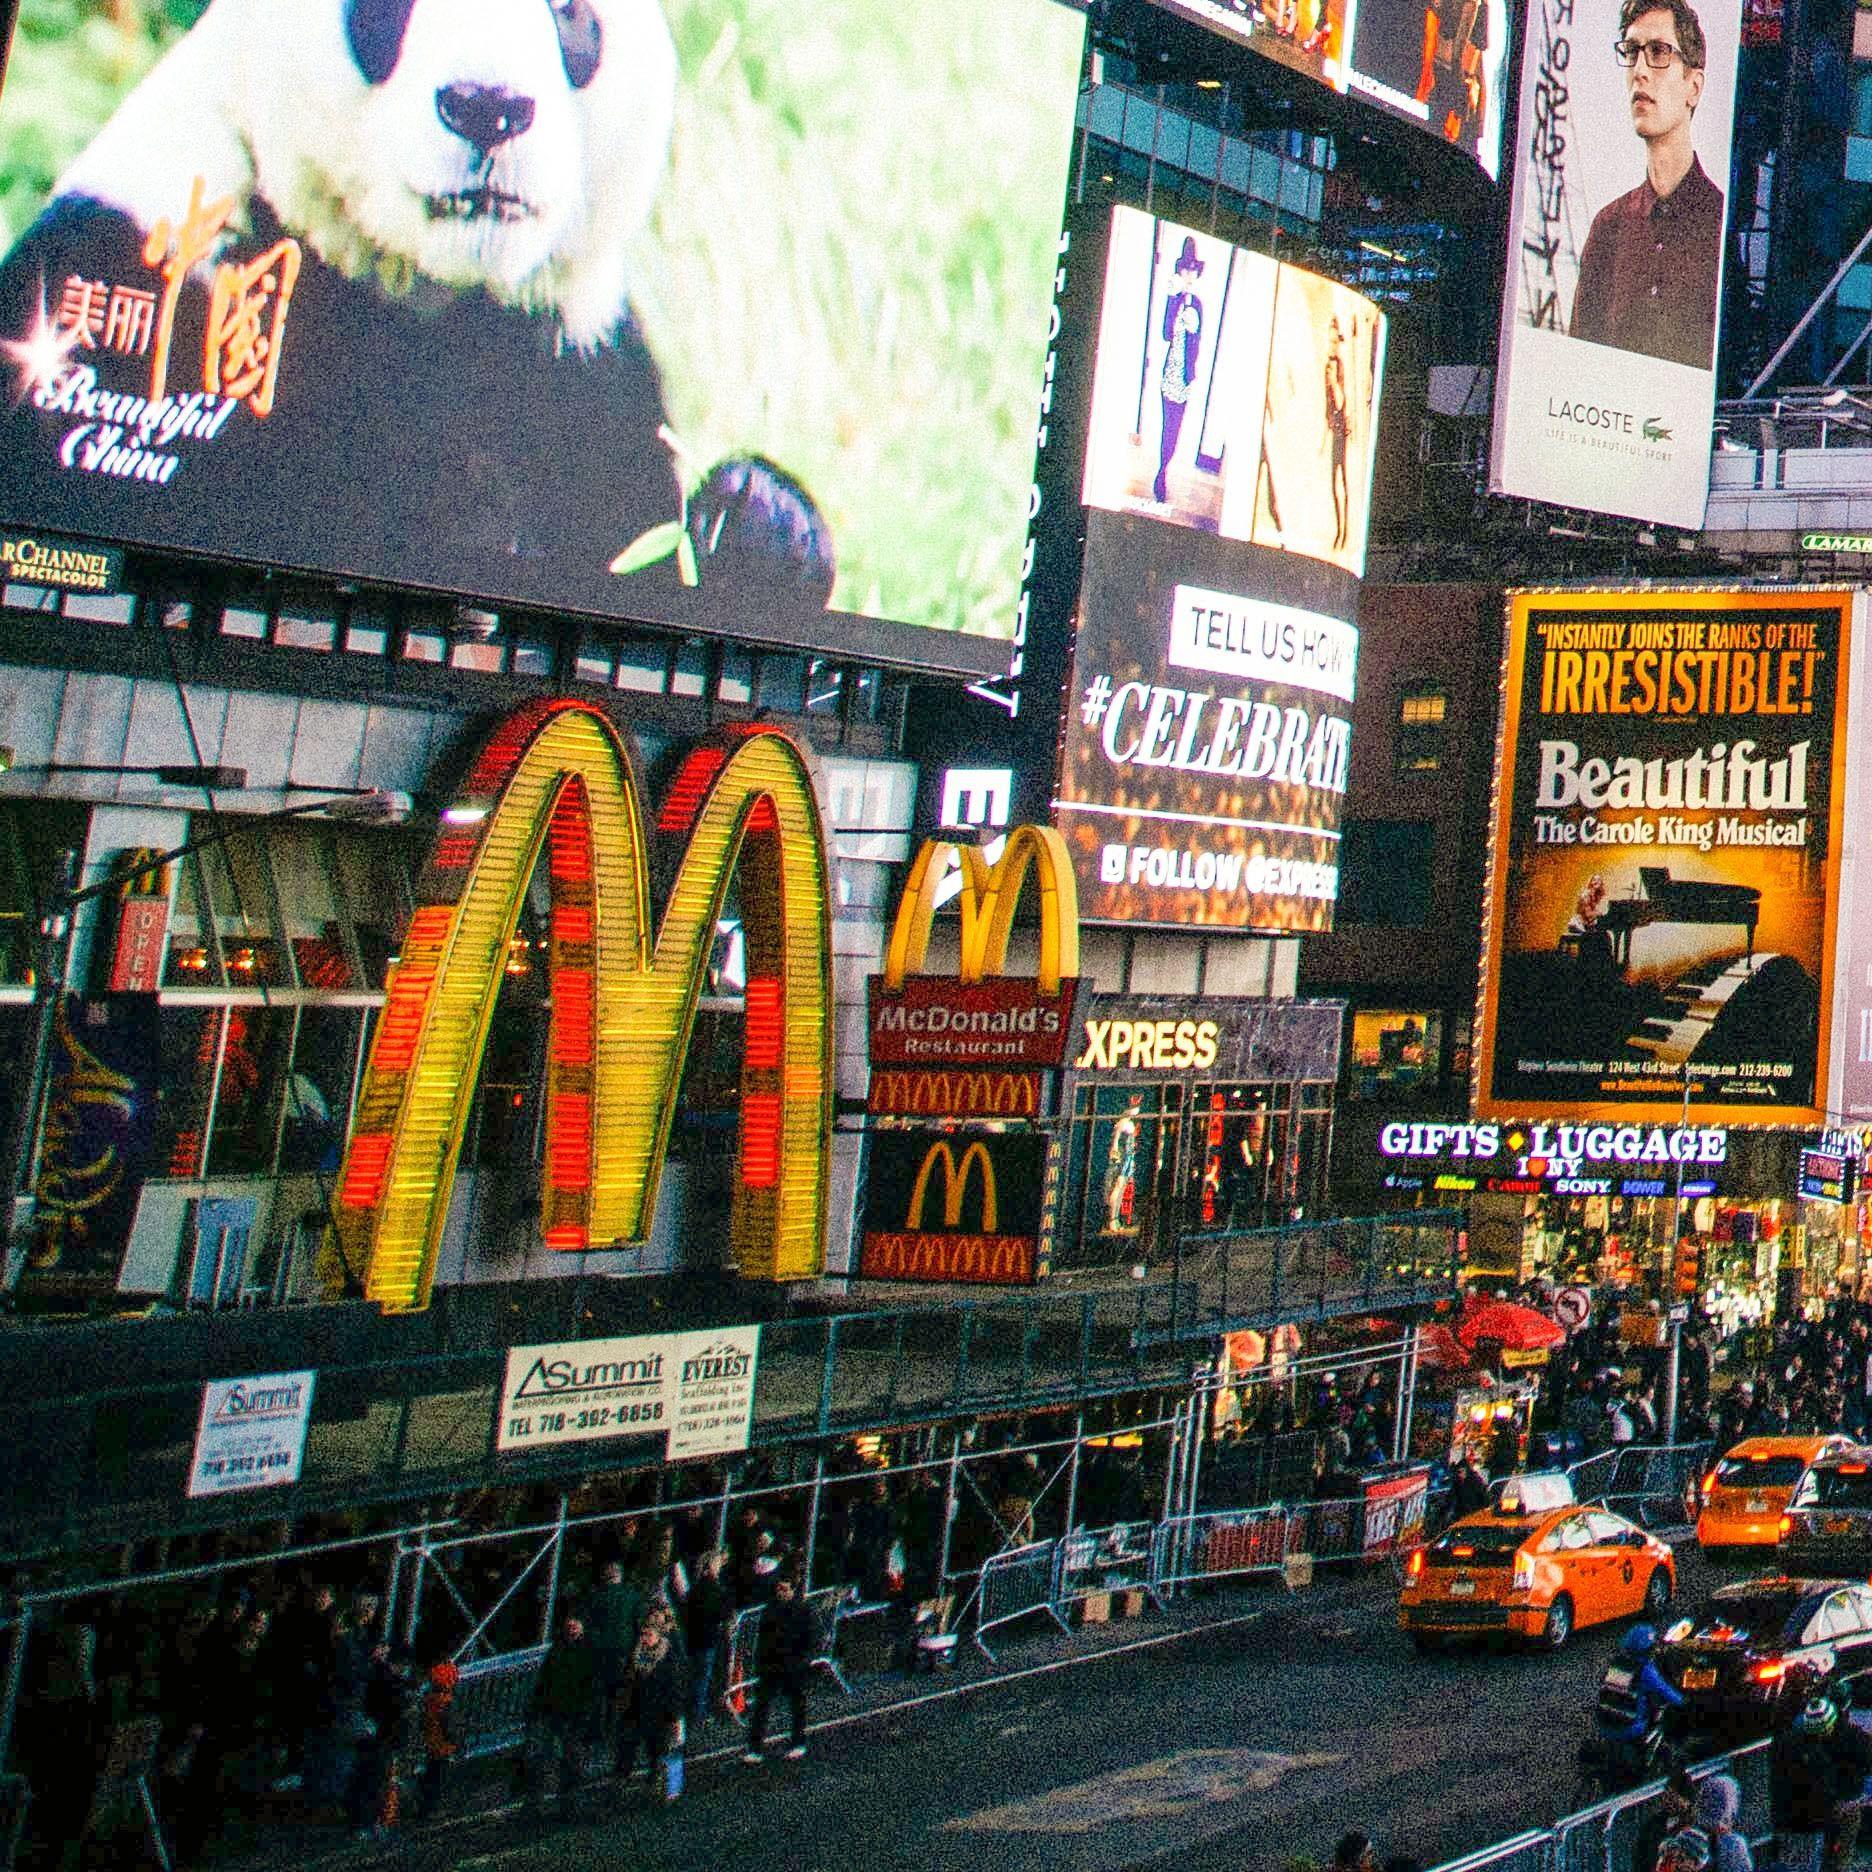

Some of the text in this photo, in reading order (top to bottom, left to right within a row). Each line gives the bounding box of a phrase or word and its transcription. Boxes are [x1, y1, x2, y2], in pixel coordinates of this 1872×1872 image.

[1547, 396, 1634, 435] LACOSTE
[1590, 436, 1642, 458] BEAUTIFUL
[1645, 447, 1675, 463] SPORT
[10, 563, 107, 589] SPECTACOLOR
[1190, 605, 1252, 656] TELL
[1261, 619, 1295, 663] US
[1627, 622, 1675, 650] JOINS
[1675, 622, 1706, 650] THE
[1708, 622, 1761, 650] RANKS
[1766, 623, 1789, 650] OF
[1789, 623, 1817, 650] THE
[1535, 738, 1812, 812] Beautiful
[1534, 815, 1807, 850] The Carole King Musical
[1129, 846, 1246, 892] FOLLOW
[876, 1004, 1061, 1036] McDonald's
[904, 1036, 1026, 1056] Restaurant
[1076, 1019, 1219, 1070] XPRESS
[1380, 1122, 1728, 1163] GIFTS LUGGAGE
[1517, 1156, 1583, 1178] I NY
[1433, 1174, 1477, 1191] Nikon
[1554, 1179, 1612, 1196] SONY
[543, 1352, 665, 1389] Summit
[681, 1353, 753, 1384] EVEREST
[508, 1415, 533, 1438] TEL
